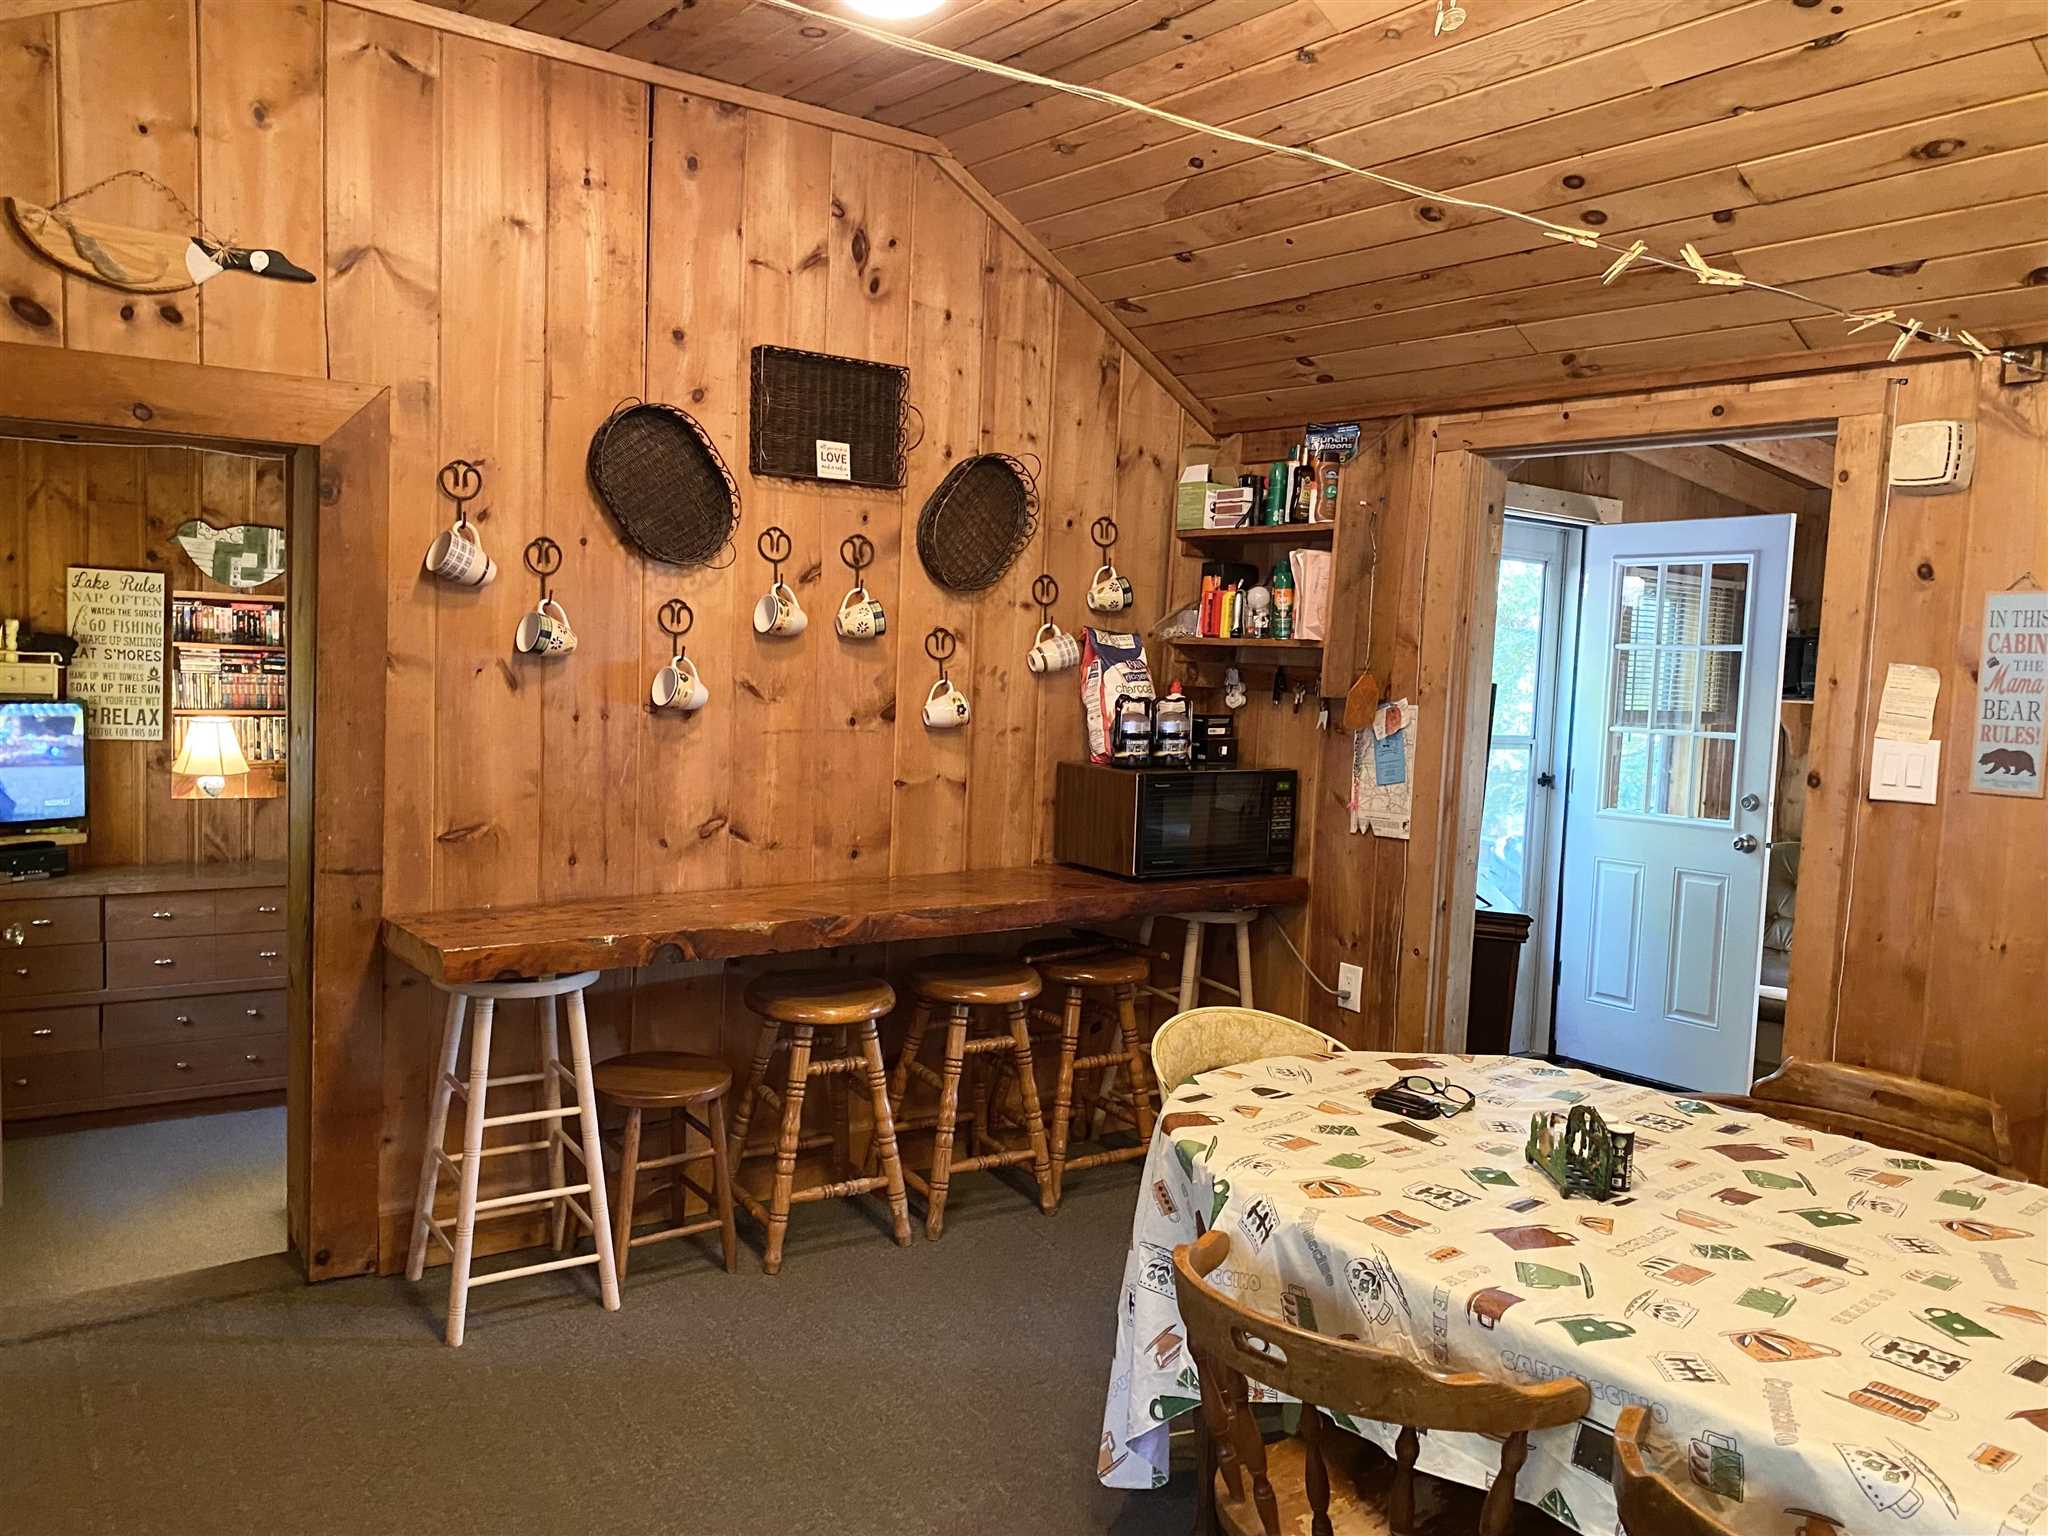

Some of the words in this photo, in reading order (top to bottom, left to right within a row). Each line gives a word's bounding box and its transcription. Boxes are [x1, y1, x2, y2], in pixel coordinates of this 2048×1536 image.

[820, 451, 847, 465] LOVE
[72, 571, 111, 590] Lake
[120, 574, 162, 593] Rules
[72, 591, 103, 603] NAP
[110, 594, 162, 607] OFTEN
[90, 607, 115, 616] WATCH
[118, 608, 132, 618] THE
[134, 609, 162, 619] SUNSET
[1989, 609, 2009, 628] IN
[89, 618, 106, 632] GO
[113, 620, 162, 636] FISHING
[79, 633, 108, 646] WAKE
[109, 634, 121, 646] UP
[123, 636, 162, 649] SMILING
[1988, 632, 2048, 655] CABIN
[104, 648, 162, 662] S'MORES
[2013, 659, 2045, 673] THE
[103, 672, 116, 681] WET
[119, 672, 145, 682] TOWELS
[1983, 663, 2045, 695] Mama
[70, 681, 96, 693] SOAK
[101, 683, 114, 694] UP
[117, 683, 138, 695] THE
[141, 684, 161, 695] SUN
[1115, 683, 1153, 694] charcoa
[105, 695, 123, 706] YOUR
[125, 696, 143, 706] FEET
[145, 696, 161, 707] WET
[100, 706, 160, 727] RELAX
[1982, 698, 2041, 722] BEAR
[115, 727, 129, 737] FOR
[131, 728, 145, 738] THIS
[148, 728, 161, 737] DAY
[1980, 724, 2041, 745] RULES!
